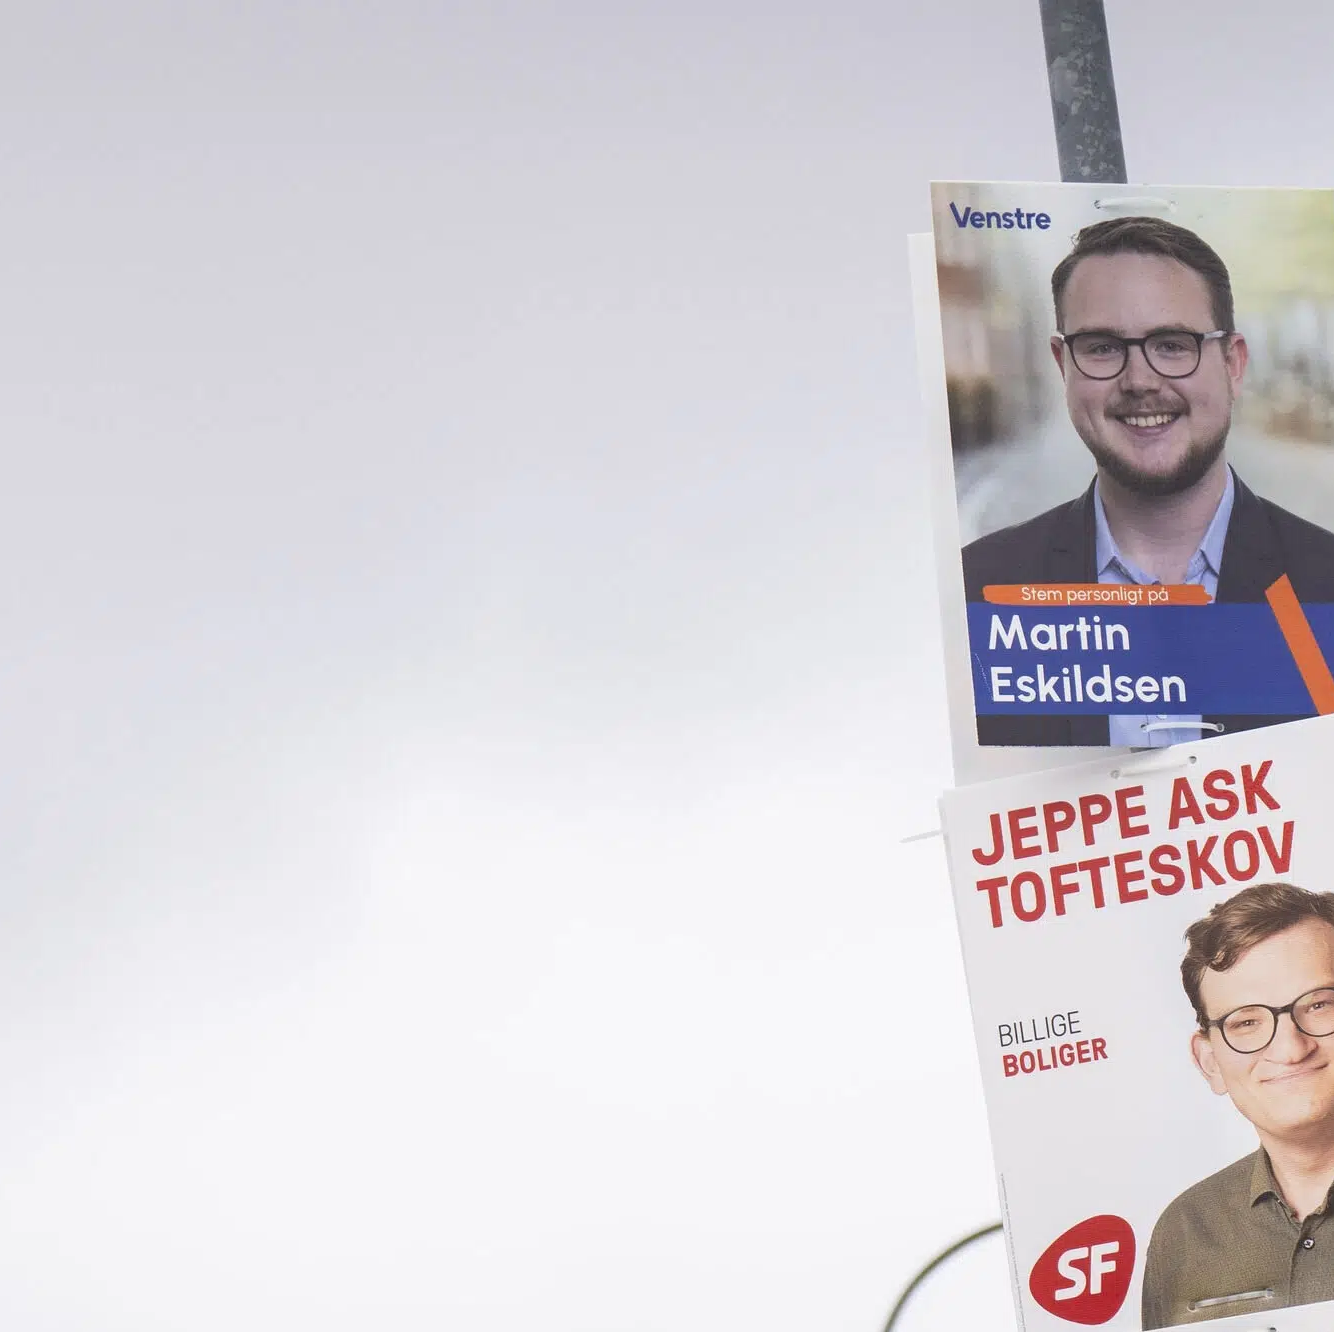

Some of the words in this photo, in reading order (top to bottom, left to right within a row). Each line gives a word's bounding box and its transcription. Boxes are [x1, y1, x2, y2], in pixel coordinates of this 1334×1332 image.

[950, 202, 1051, 230] Venstre
[1020, 587, 1063, 602] Stem
[1067, 587, 1144, 606] personligt
[1148, 587, 1170, 606] på
[988, 614, 1130, 652] Martin
[990, 664, 1187, 704] Eskildsen
[972, 785, 1150, 866] JEPPE
[1168, 760, 1281, 830] ASK
[977, 821, 1295, 928] TOFTESKOV
[998, 1011, 1082, 1047] BILLIGE
[1002, 1037, 1108, 1077] BOLIGER
[1054, 1241, 1120, 1300] SF
